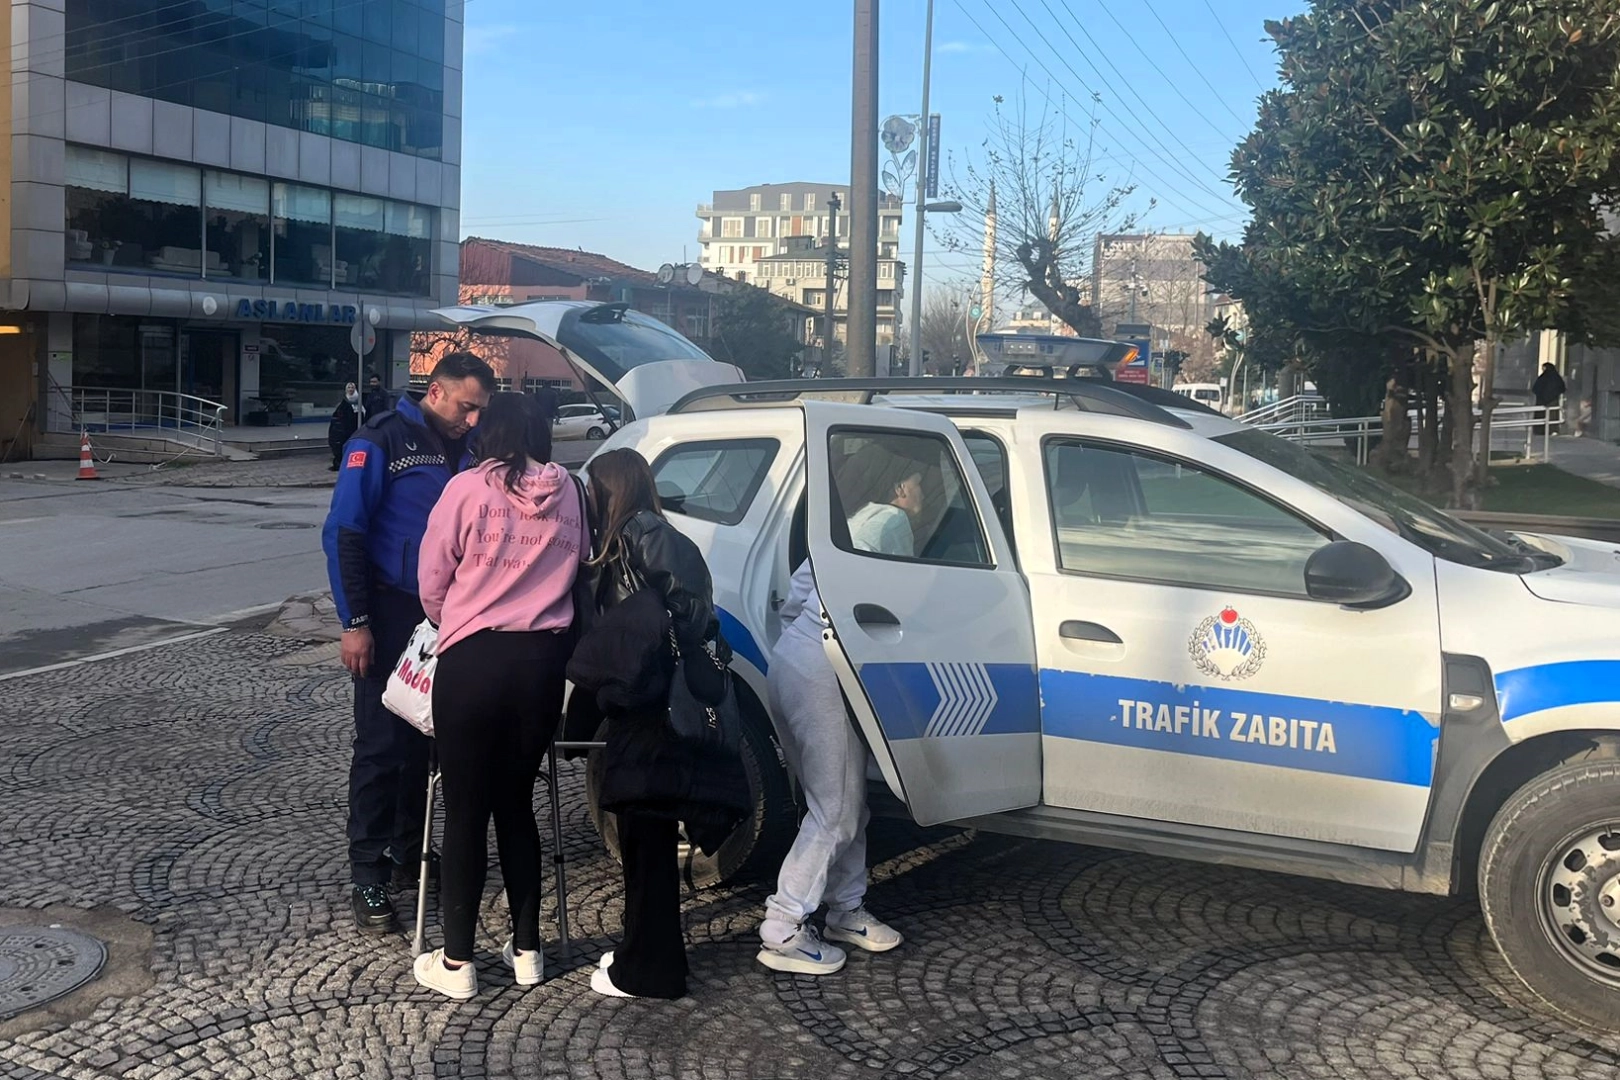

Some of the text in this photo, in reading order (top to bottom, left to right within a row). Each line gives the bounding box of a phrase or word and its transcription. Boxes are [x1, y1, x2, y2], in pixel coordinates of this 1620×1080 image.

[237, 299, 357, 323] ASLANLAR
[476, 527, 516, 544] You're
[545, 535, 580, 556] going
[397, 657, 431, 694] Moda
[1118, 699, 1337, 753] TRAFİK ZABITA
